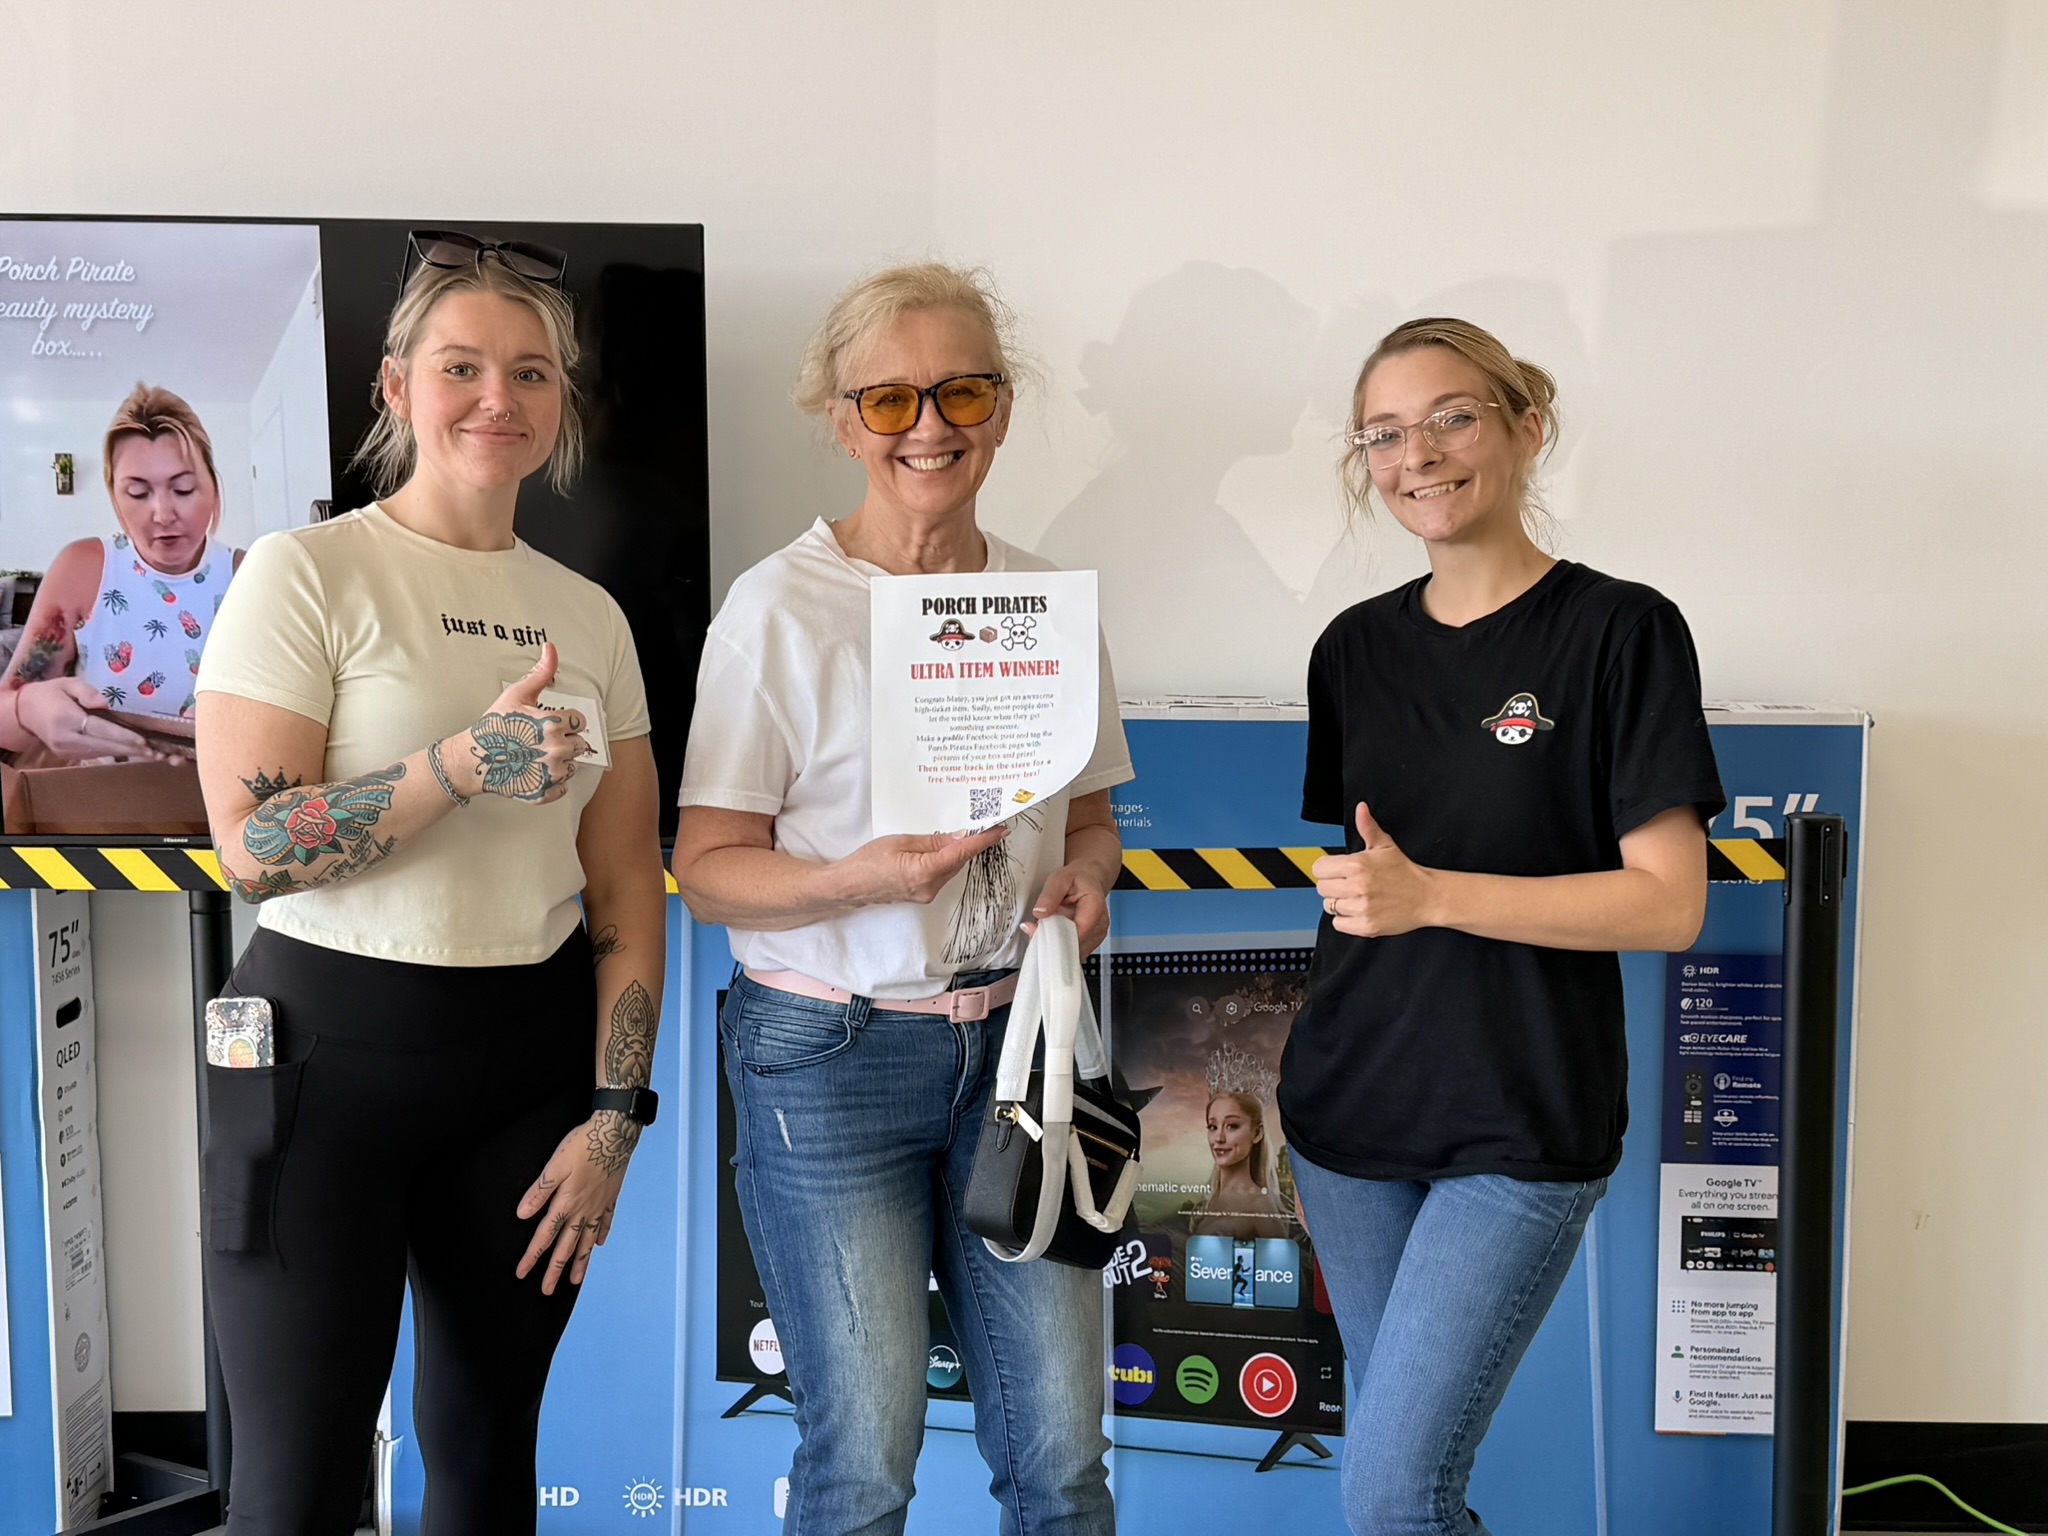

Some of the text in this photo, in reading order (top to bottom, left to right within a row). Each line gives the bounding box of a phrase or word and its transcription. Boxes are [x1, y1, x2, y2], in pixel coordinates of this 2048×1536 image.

[0, 255, 136, 282] Porch Pirate
[0, 296, 154, 332] eauty mystery
[922, 595, 1047, 615] PORCH PIRATES
[441, 613, 547, 647] just a girl
[911, 660, 1060, 679] ULTRA ITEM WINNER!
[914, 696, 945, 704] Congrats
[1012, 703, 1035, 711] people
[1013, 713, 1028, 721] they
[950, 724, 984, 732] something
[942, 734, 964, 742] public
[928, 744, 948, 752] Porch
[974, 742, 1007, 750] Facebook
[1026, 740, 1041, 748] with
[971, 754, 986, 762] your
[988, 752, 1000, 760] box
[1002, 751, 1015, 759] and
[918, 765, 938, 773] Then
[964, 763, 983, 771] back
[986, 762, 994, 770] in
[1011, 761, 1030, 769] store
[927, 775, 944, 783] free
[989, 772, 1020, 782] mystery
[1023, 770, 1040, 778] box!
[1110, 804, 1143, 815] mages
[1709, 793, 1819, 839] 5"
[1114, 817, 1152, 827] terials
[49, 919, 79, 968] 75"
[1254, 1001, 1303, 1014] Google TV
[1695, 998, 1713, 1008] 120
[1700, 1034, 1748, 1043] EYECARE
[57, 1041, 80, 1069] QLED
[1134, 1181, 1211, 1194] nematic event
[1706, 1178, 1742, 1189] Google
[1679, 1189, 1728, 1200] Everything
[1730, 1192, 1747, 1200] you
[1691, 1201, 1701, 1209] all
[1717, 1202, 1735, 1210] one
[1737, 1203, 1770, 1211] screen.
[1127, 1240, 1152, 1279] 2
[1103, 1262, 1132, 1288] OUT
[1691, 1300, 1702, 1308] No
[1726, 1302, 1758, 1311] jumping
[754, 1339, 779, 1352] NETFL
[1690, 1345, 1740, 1354] Personalized
[1690, 1354, 1761, 1362] recommendations
[1108, 1365, 1153, 1383] tubi
[1689, 1390, 1706, 1398] Find
[1715, 1391, 1740, 1399] faster.
[1319, 1402, 1342, 1413] Reor
[1689, 1398, 1721, 1407] Google.
[540, 1487, 580, 1507] HD
[673, 1488, 728, 1507] HDR
